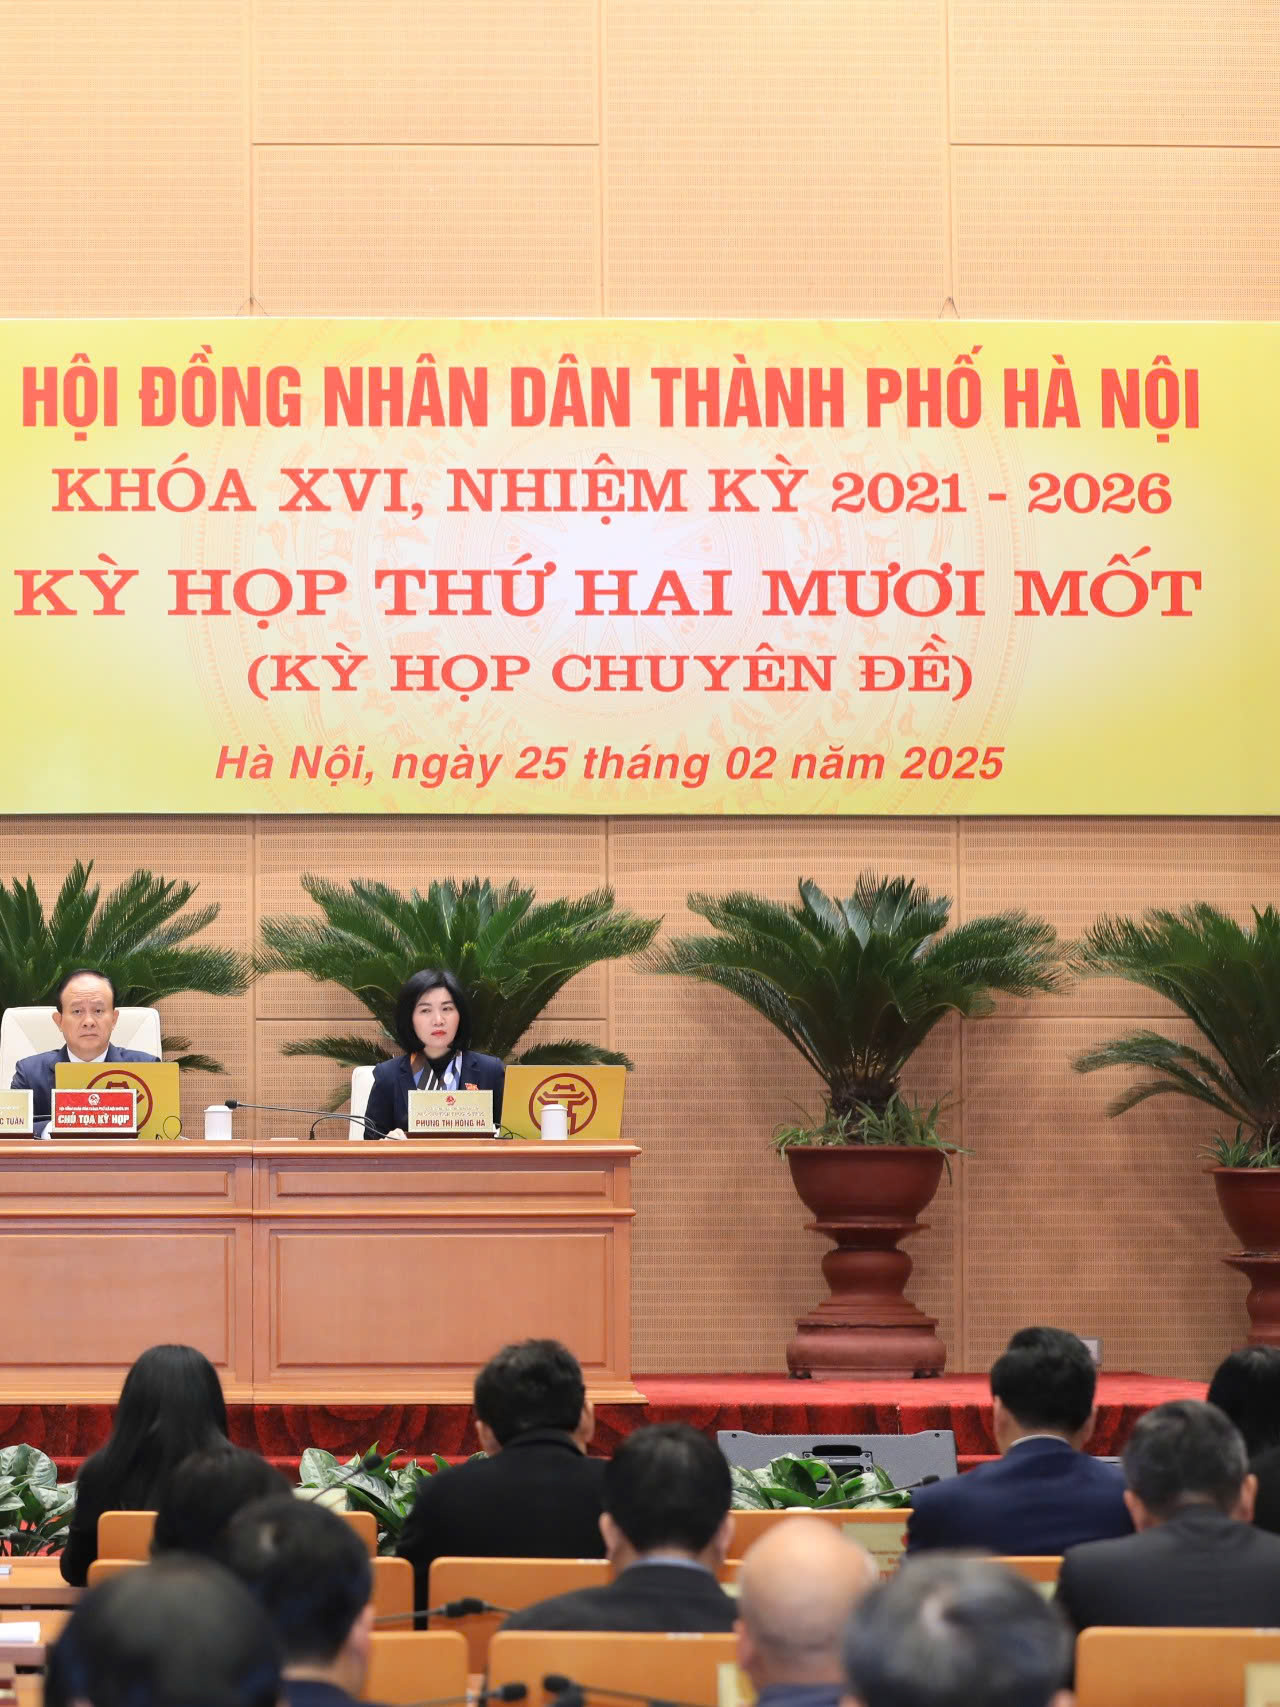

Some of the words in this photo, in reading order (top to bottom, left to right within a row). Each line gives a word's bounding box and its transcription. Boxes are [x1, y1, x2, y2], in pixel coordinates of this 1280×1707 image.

[23, 353, 117, 441] HỘI
[139, 345, 301, 427] ĐỒNG
[324, 353, 488, 427] NHÂN
[511, 353, 630, 427] DÂN
[651, 354, 844, 427] THÀNH
[867, 346, 982, 428] PHỐ
[1004, 355, 1081, 428] HÀ
[1101, 355, 1199, 443] NỘI
[51, 453, 256, 512] KHÓA
[279, 468, 423, 519] XVI,
[447, 454, 687, 525] NHIỆM
[709, 454, 809, 512] KỲ
[831, 473, 967, 513] 2021
[988, 493, 1007, 501] -
[1028, 473, 1172, 514] 2026
[14, 553, 139, 616] KỲ
[167, 568, 347, 629] HỌP
[375, 553, 556, 616] THỨ
[575, 570, 733, 616] HAI
[762, 562, 986, 617] MƯƠI
[1014, 546, 1202, 617] MỐT
[247, 642, 368, 701] (KỲ
[390, 654, 530, 702] HỌP
[552, 643, 837, 693] CHUYÊN
[858, 634, 973, 701] ĐỀ)
[215, 746, 274, 779] Hà
[290, 745, 373, 785] Nội,
[392, 746, 503, 789] ngày
[515, 747, 569, 779] 25
[584, 746, 710, 789] tháng
[726, 746, 777, 780] 02
[791, 746, 885, 780] năm
[900, 747, 1005, 780] 2025
[78, 1114, 96, 1125] TỌA
[111, 1114, 130, 1125] HỌP
